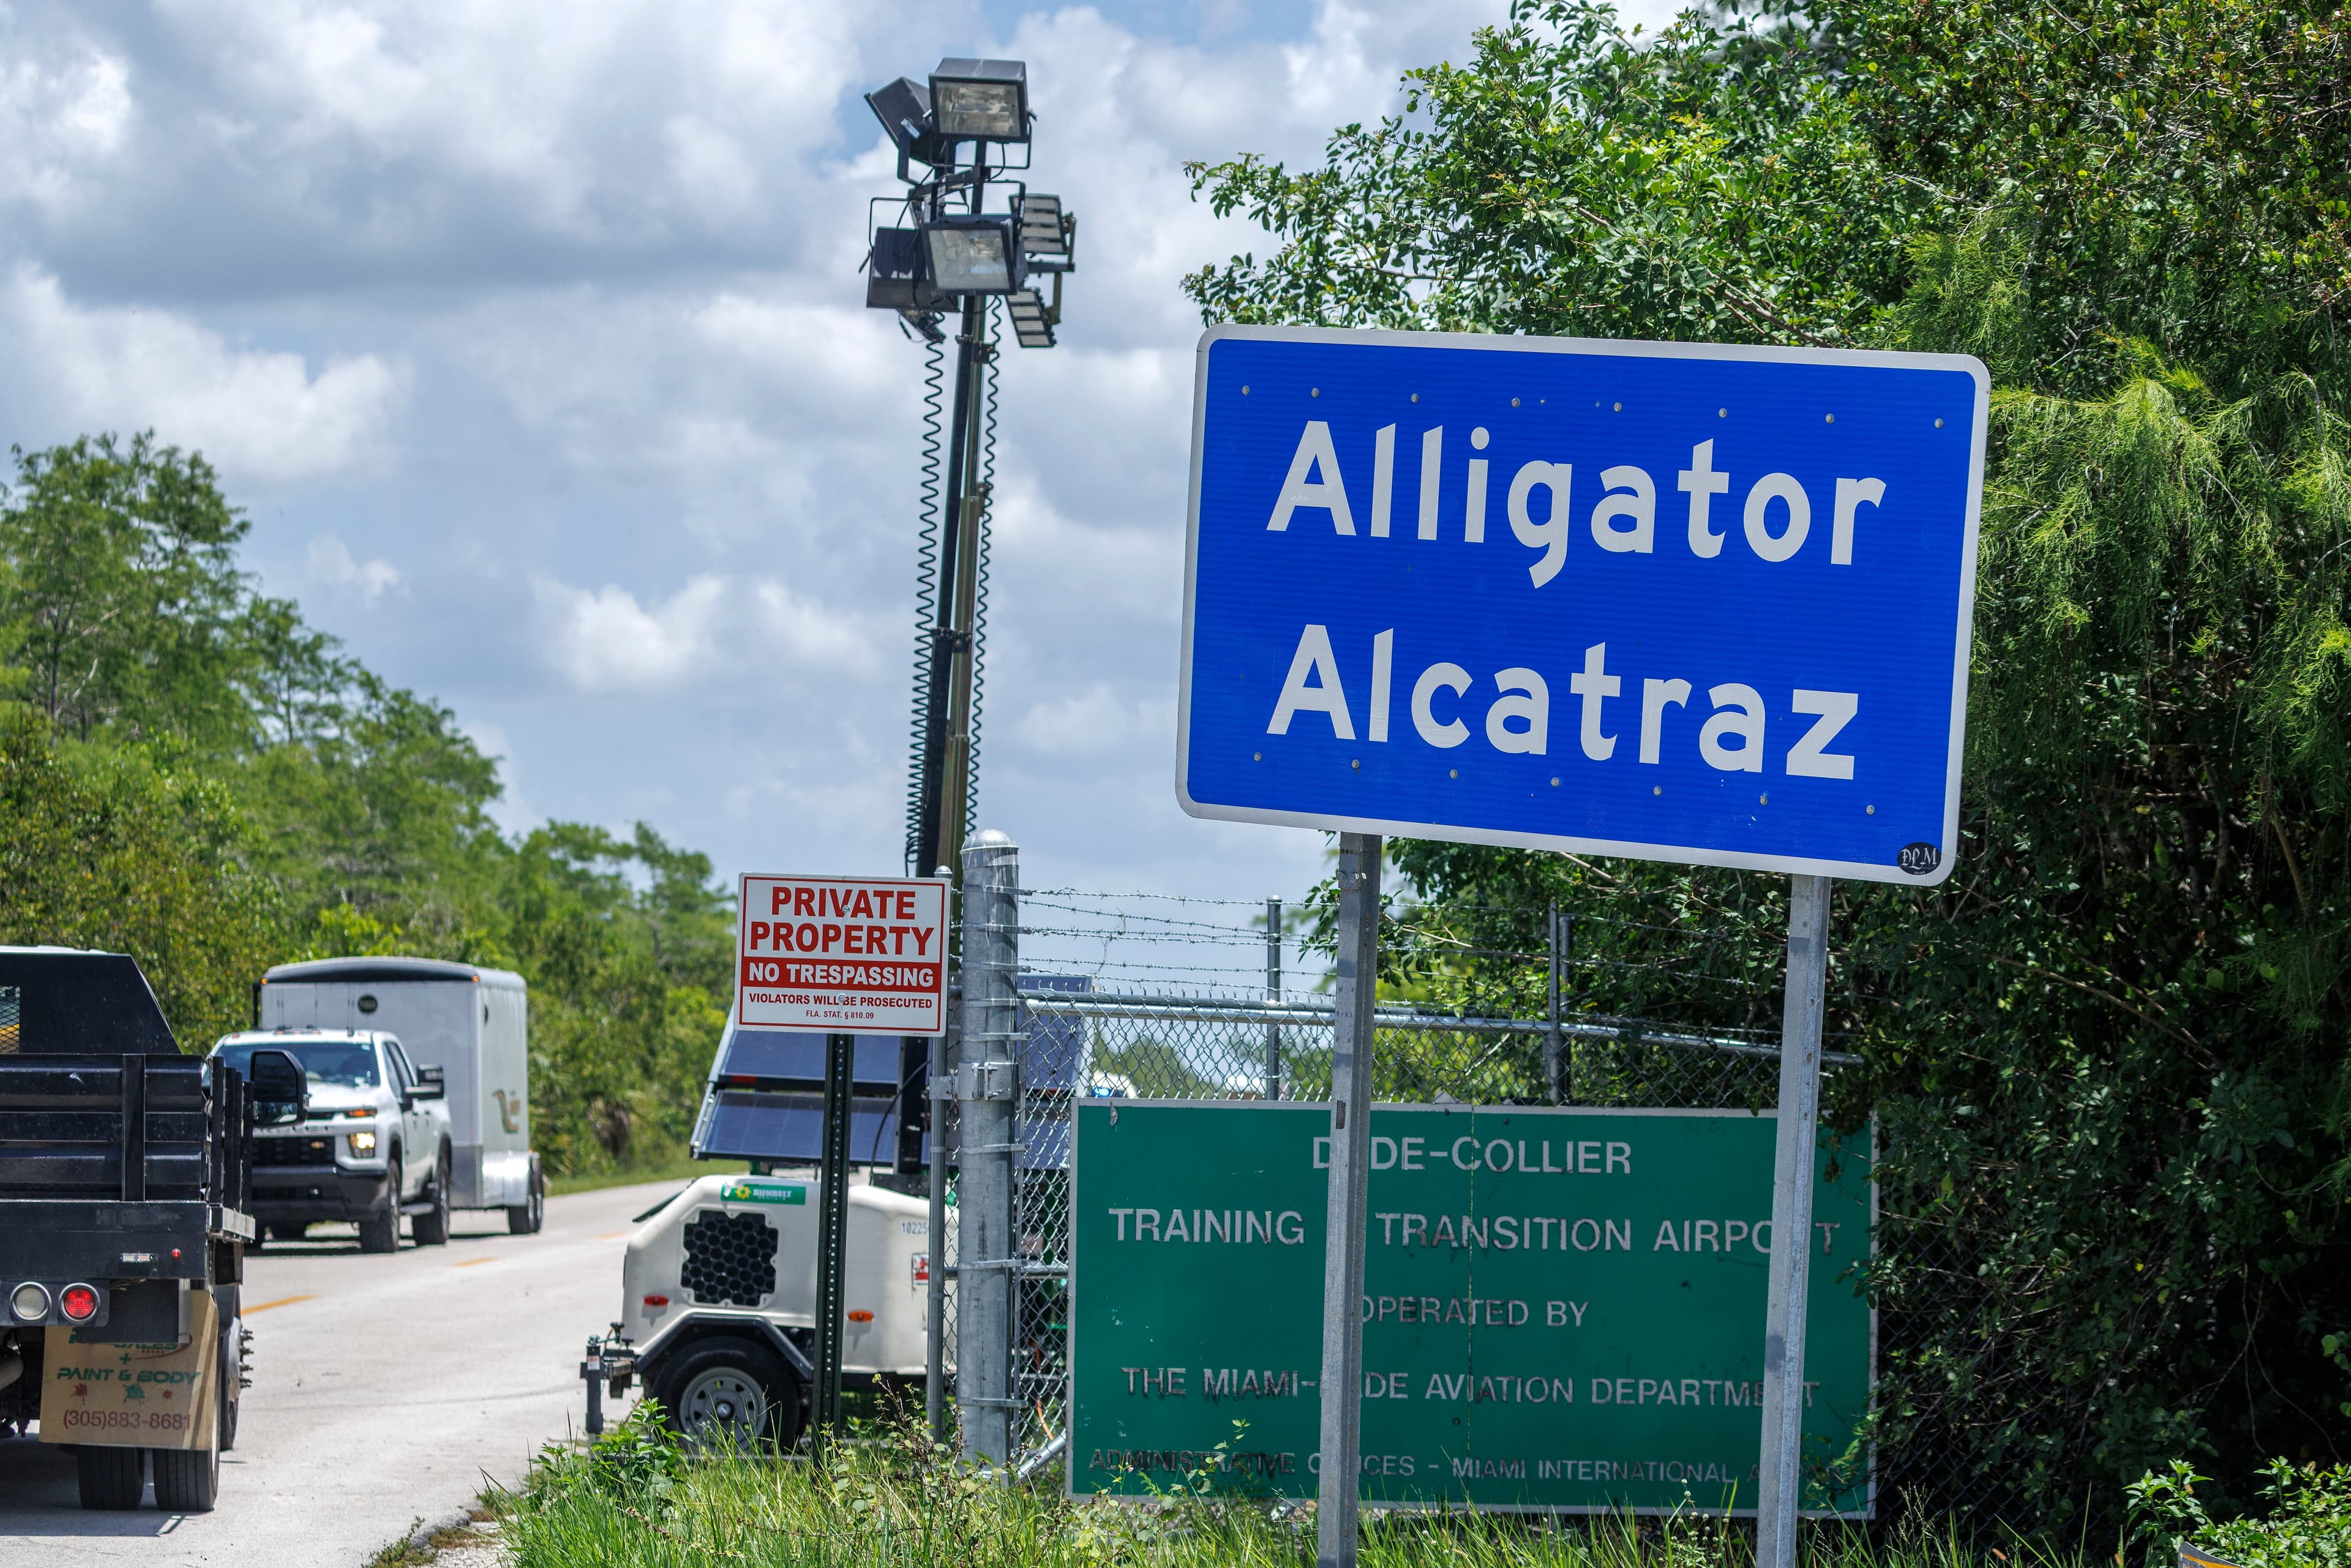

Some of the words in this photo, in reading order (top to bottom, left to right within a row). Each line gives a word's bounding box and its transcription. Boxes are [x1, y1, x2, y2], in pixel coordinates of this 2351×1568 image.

[1266, 421, 1887, 588] Alligator
[1267, 624, 1859, 780] Alcatraz
[771, 887, 916, 920] PRIVATE
[750, 921, 935, 956] PROPERTY
[749, 962, 779, 982] NO
[786, 964, 934, 988] TRESPASSING
[749, 993, 810, 1005] VIOLATORS
[813, 996, 839, 1006] WILL
[842, 997, 857, 1007] BE
[860, 997, 932, 1008] PROSECUTED
[1313, 1137, 1632, 1174] DDE-COLLIER
[1109, 1209, 1305, 1245] TRAINING
[1375, 1213, 1632, 1251] TRANSITION
[1653, 1220, 1840, 1255] AIRPOT
[1547, 1300, 1589, 1327] BY
[57, 1367, 114, 1381] PAINT
[118, 1369, 132, 1382] &
[137, 1371, 201, 1384] BODY
[1122, 1367, 1187, 1396] THE
[1203, 1368, 1408, 1398] MIAMI-DE
[1425, 1373, 1573, 1403] AVIATION
[1592, 1378, 1820, 1407] DEPARTMET
[63, 1409, 191, 1430] (305)883-8681
[1453, 1457, 1526, 1479] MIAMI
[1539, 1460, 1734, 1483] INTERNATIONAL
